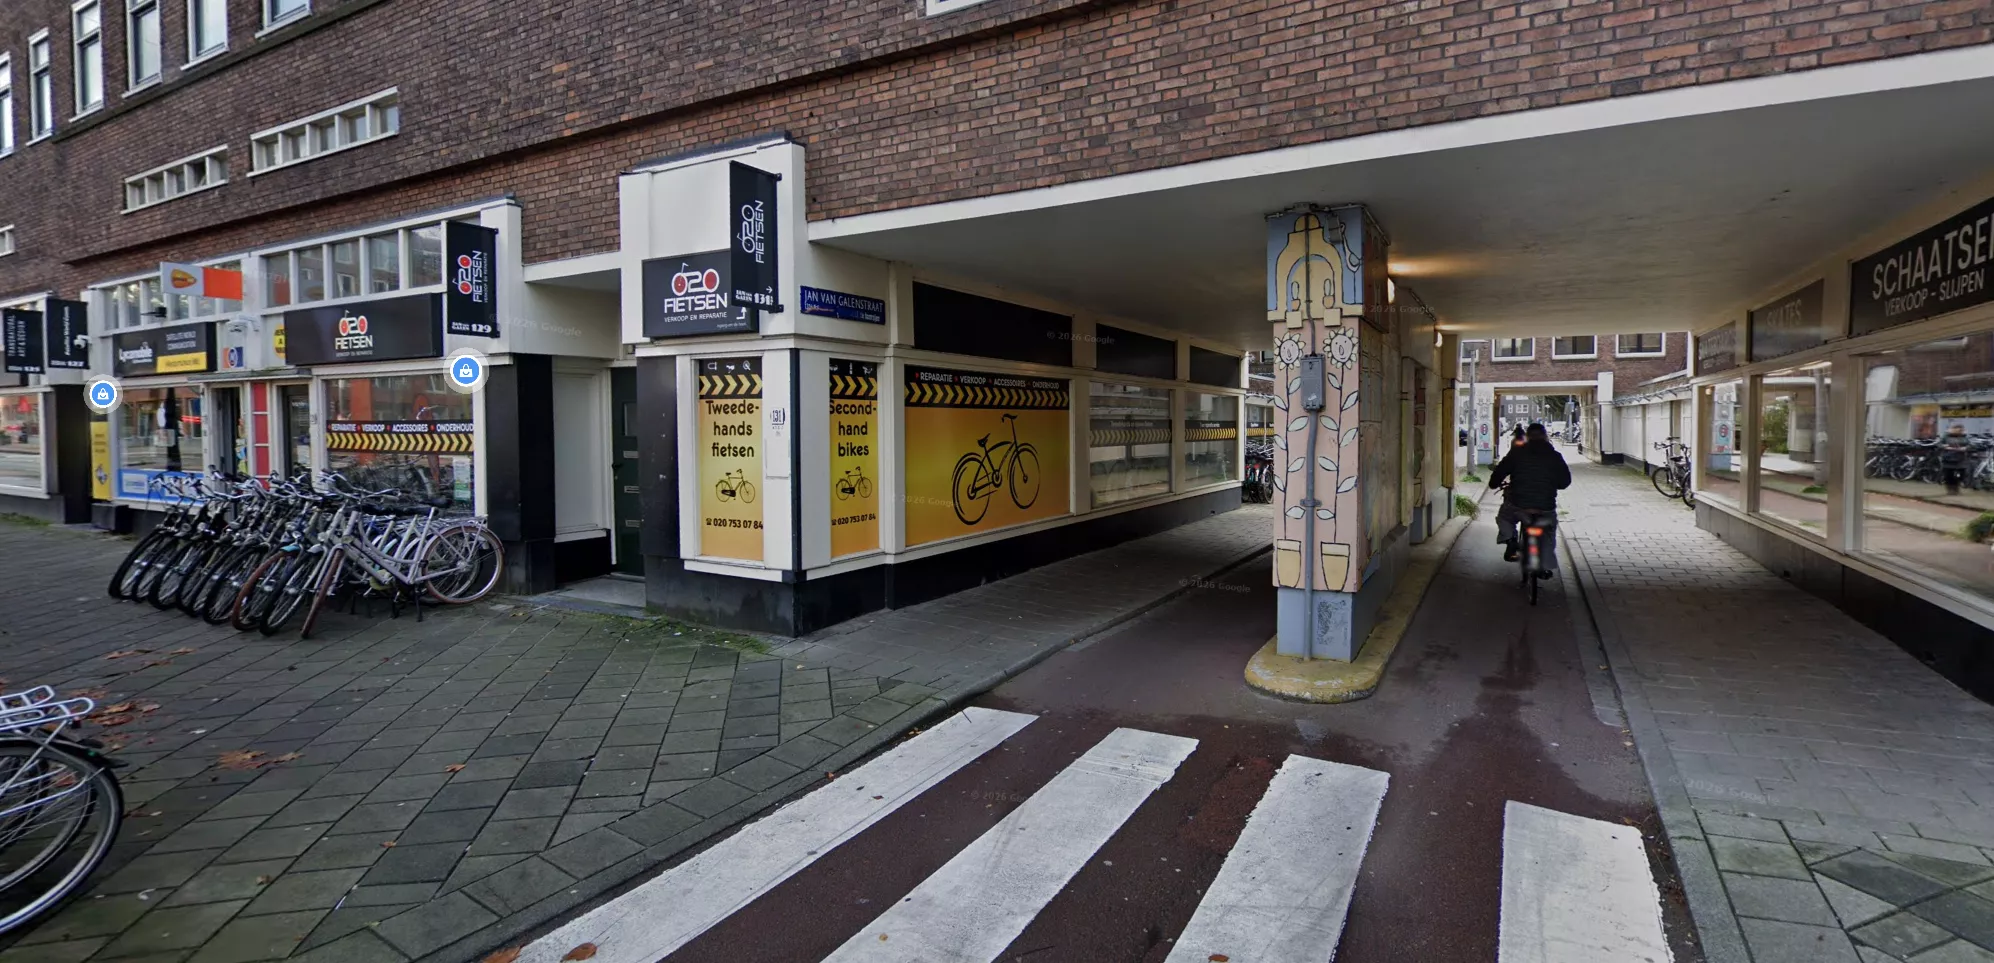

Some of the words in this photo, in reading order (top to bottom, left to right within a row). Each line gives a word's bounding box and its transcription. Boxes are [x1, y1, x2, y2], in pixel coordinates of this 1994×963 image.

[741, 205, 755, 253] 020
[755, 200, 764, 264] FIETSEN
[458, 255, 472, 294] 020
[472, 250, 482, 302] FIETSEN
[671, 269, 719, 296] 020
[1884, 288, 1928, 317] VERKOOP
[1939, 268, 1985, 301] SLIJPEN
[664, 292, 728, 313] FIETSEN
[804, 289, 819, 302] JAN
[820, 292, 836, 305] VAN
[838, 296, 883, 312] GALENSTRAAT
[664, 315, 688, 323] VERKOOP
[700, 312, 727, 320] REPARATIE
[339, 315, 368, 336] 020
[471, 323, 492, 333] 129
[335, 335, 373, 349] FIETSEN
[920, 372, 952, 383] REPARATIE
[960, 376, 986, 385] VERKOOP
[993, 379, 1026, 388] ACCESSOIRES
[1032, 381, 1059, 390] ONDERHOUD
[705, 400, 760, 415] Tweede-
[829, 400, 877, 415] Second-
[772, 409, 782, 423] 131
[331, 424, 356, 432] REPARATIE
[361, 424, 385, 432] VERKOOP
[392, 423, 428, 432] ACCESSOIRES
[436, 423, 474, 432] ONDERHOUD
[713, 421, 753, 436] hands
[838, 421, 868, 436] hand
[712, 442, 755, 457] fietsen
[838, 442, 869, 457] bikes
[713, 518, 727, 528] 020
[728, 519, 741, 528] 753
[743, 520, 753, 529] 07
[753, 521, 764, 530] 84
[837, 517, 849, 526] 020
[849, 515, 860, 524] 753
[861, 514, 868, 523] 07
[868, 513, 876, 521] 84
